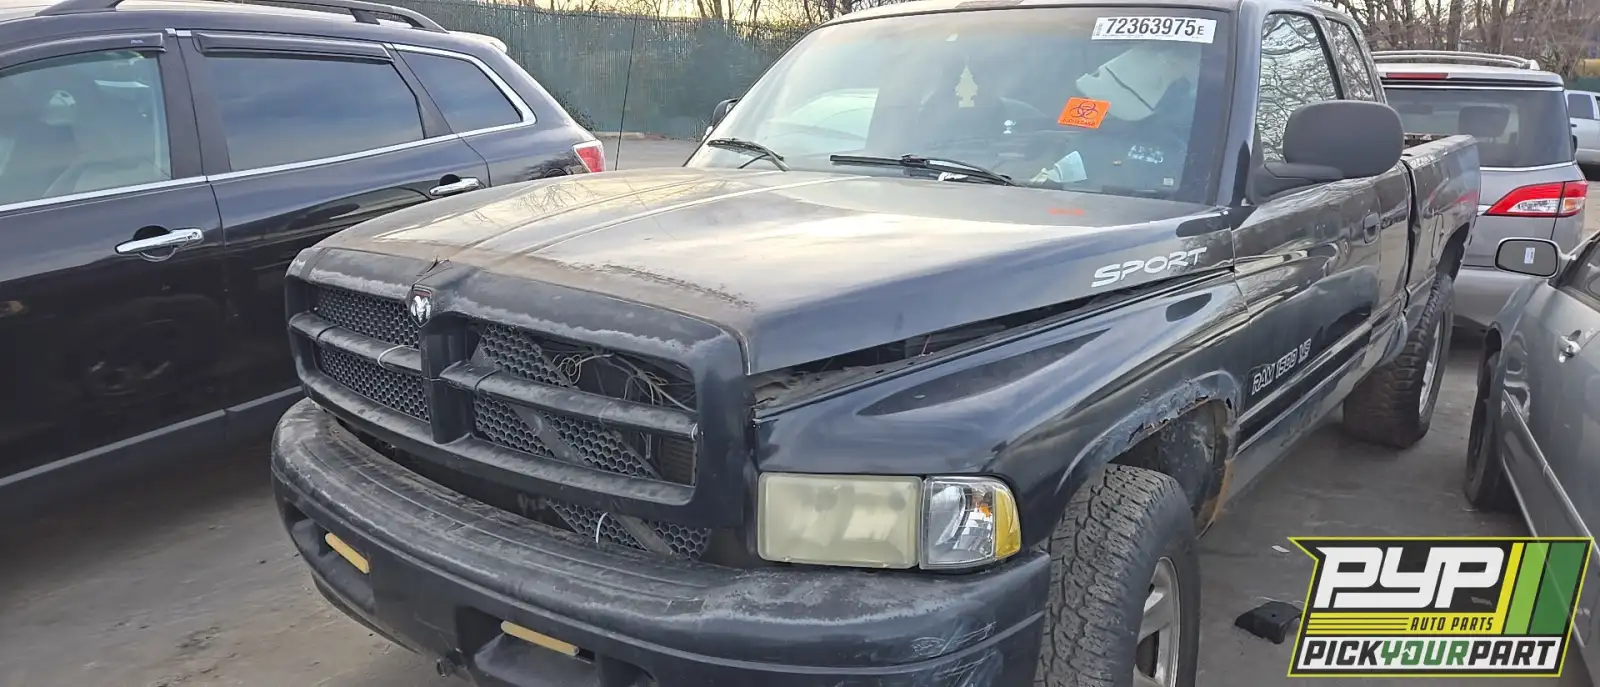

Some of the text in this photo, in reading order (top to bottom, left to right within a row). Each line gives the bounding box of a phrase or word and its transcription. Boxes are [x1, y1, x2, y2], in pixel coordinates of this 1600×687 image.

[1091, 246, 1207, 288] SPORT
[1251, 363, 1275, 396] RAM
[1276, 348, 1298, 379] 1500
